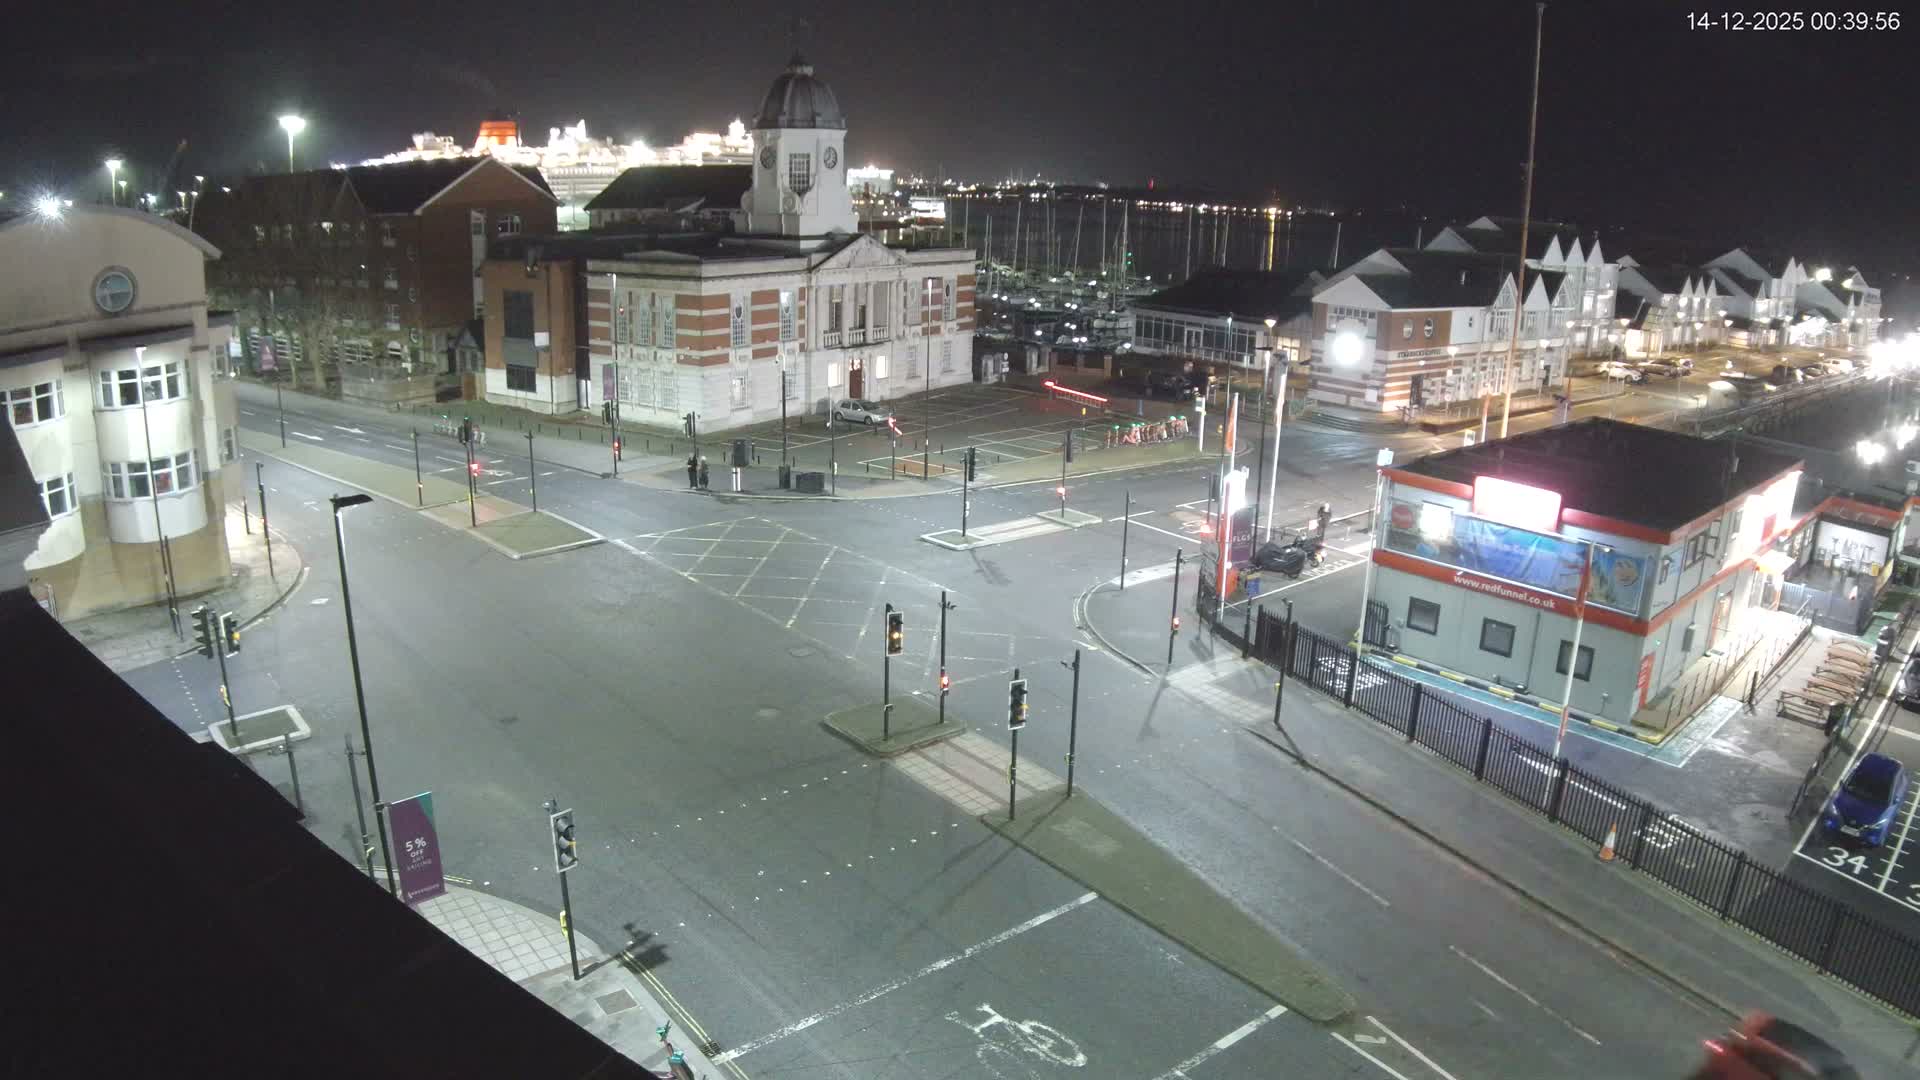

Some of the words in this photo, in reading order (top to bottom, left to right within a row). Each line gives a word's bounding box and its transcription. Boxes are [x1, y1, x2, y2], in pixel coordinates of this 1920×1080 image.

[1454, 576, 1555, 608] www.redfunnel.co.uk
[410, 849, 423, 858] OFF
[1822, 846, 1869, 875] 34
